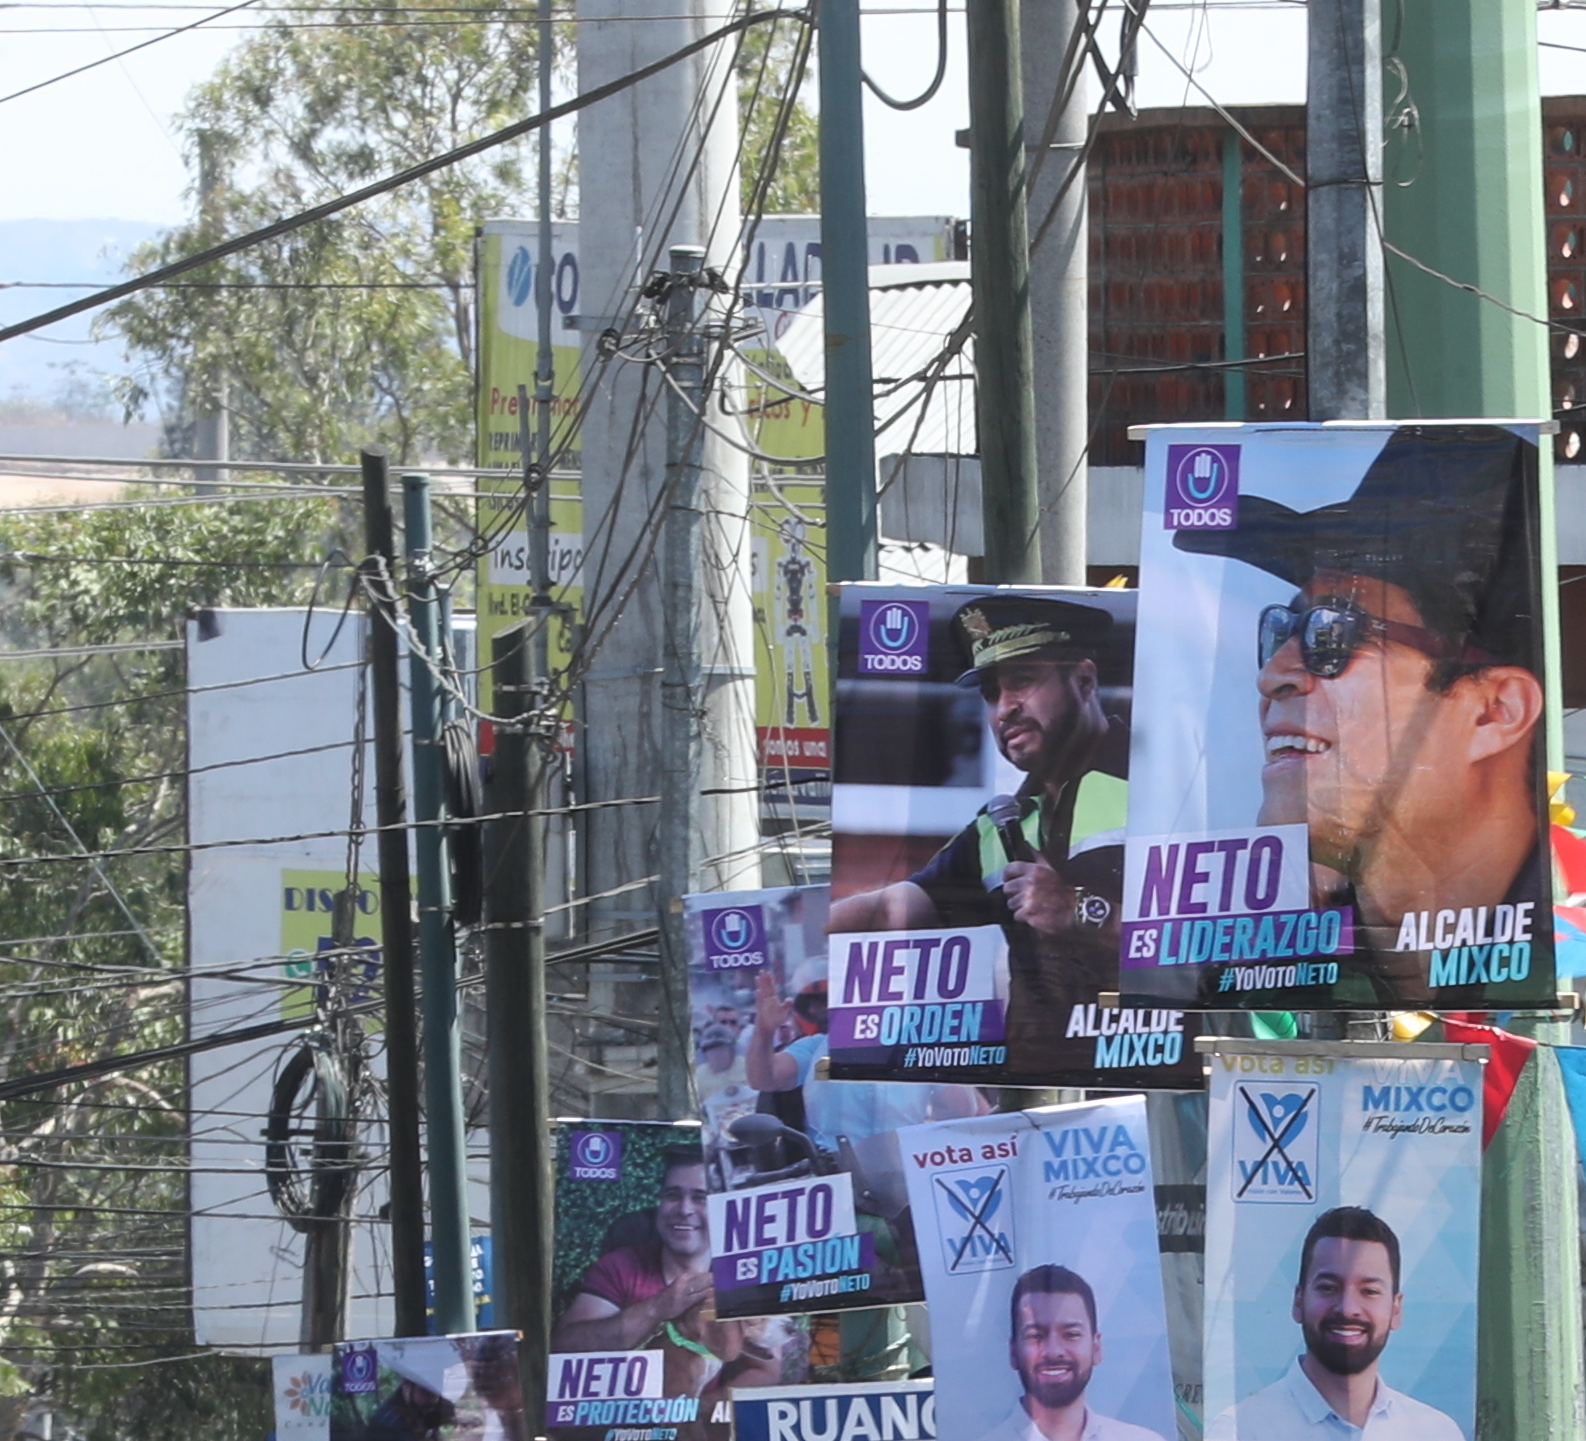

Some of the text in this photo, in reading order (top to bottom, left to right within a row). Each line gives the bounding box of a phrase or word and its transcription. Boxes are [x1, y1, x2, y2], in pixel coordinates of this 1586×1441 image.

[1170, 508, 1233, 528] TODOS
[864, 653, 922, 671] TODOS
[1138, 835, 1284, 918] NETO
[1128, 911, 1342, 966] ES LIDERAZGO
[1396, 902, 1535, 952] ALCALDE
[710, 951, 764, 968] TODOS
[842, 936, 971, 1004] NETO
[1429, 942, 1532, 988] MIXCO
[854, 1002, 984, 1046] ES ORDEN
[1065, 1005, 1184, 1038] ALCALDE
[1094, 1032, 1184, 1068] MIXCO
[1362, 1085, 1476, 1113] MIXCO
[913, 1136, 1018, 1169] vota así
[1043, 1124, 1137, 1159] VIVA
[574, 1167, 617, 1180] TODOS
[1043, 1152, 1147, 1184] MIXCO
[1237, 1160, 1312, 1186] VIVA
[723, 1183, 834, 1253] NETO
[736, 1233, 861, 1285] ES PASIÓN
[946, 1232, 1012, 1258] VIVA
[558, 1356, 649, 1399] NETO
[556, 1406, 575, 1422] ES
[575, 1393, 700, 1425] PROTECCIÓN
